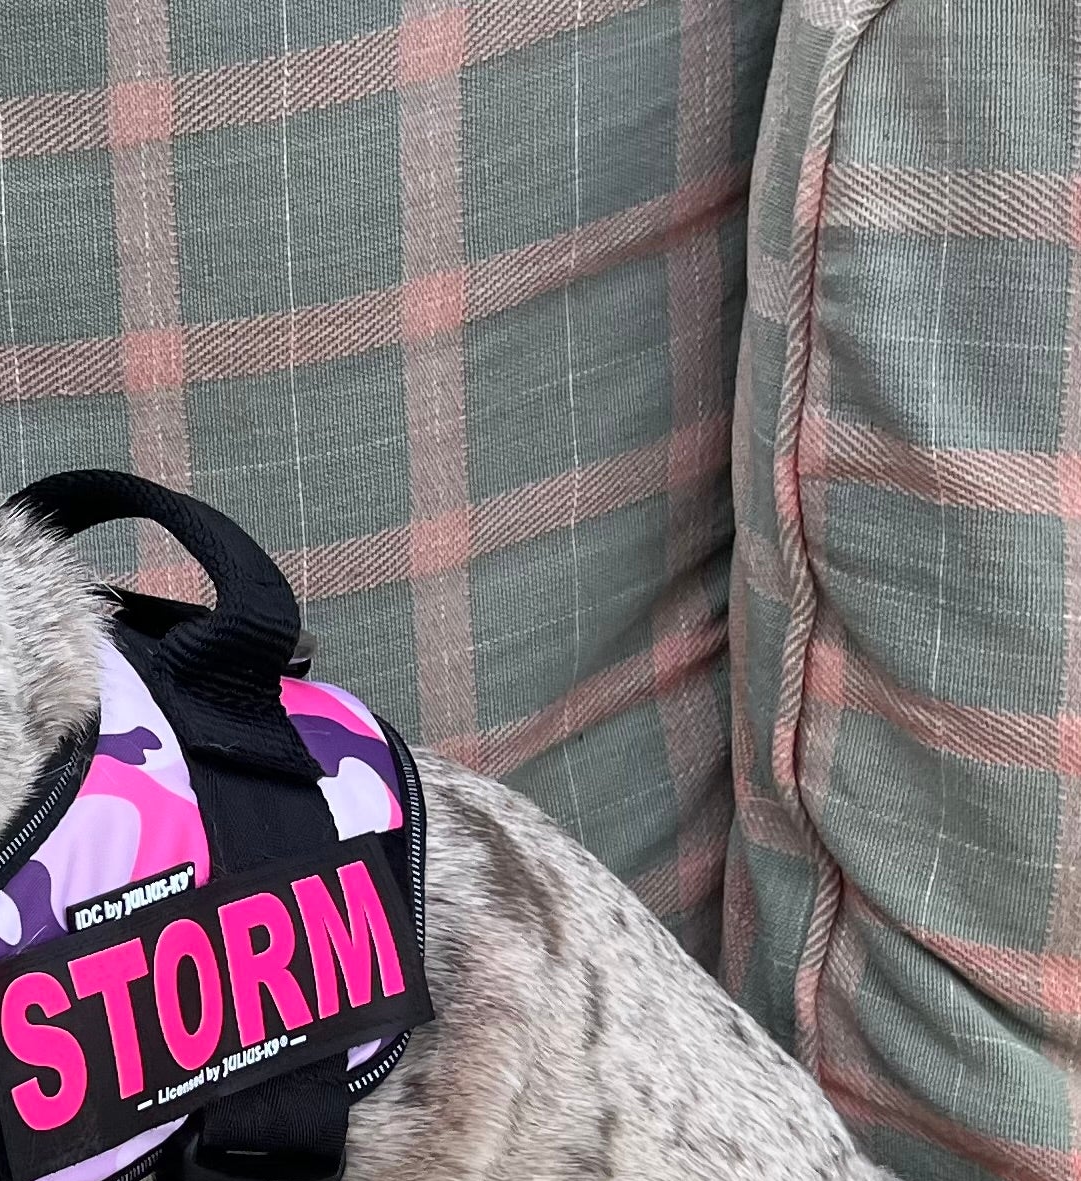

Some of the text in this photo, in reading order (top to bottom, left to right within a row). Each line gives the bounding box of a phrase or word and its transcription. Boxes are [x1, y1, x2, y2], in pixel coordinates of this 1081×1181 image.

[74, 903, 104, 931] IDC
[103, 900, 123, 920] by
[0, 860, 406, 1132] STORM
[157, 1069, 205, 1105] Licensed
[205, 1064, 221, 1082] by
